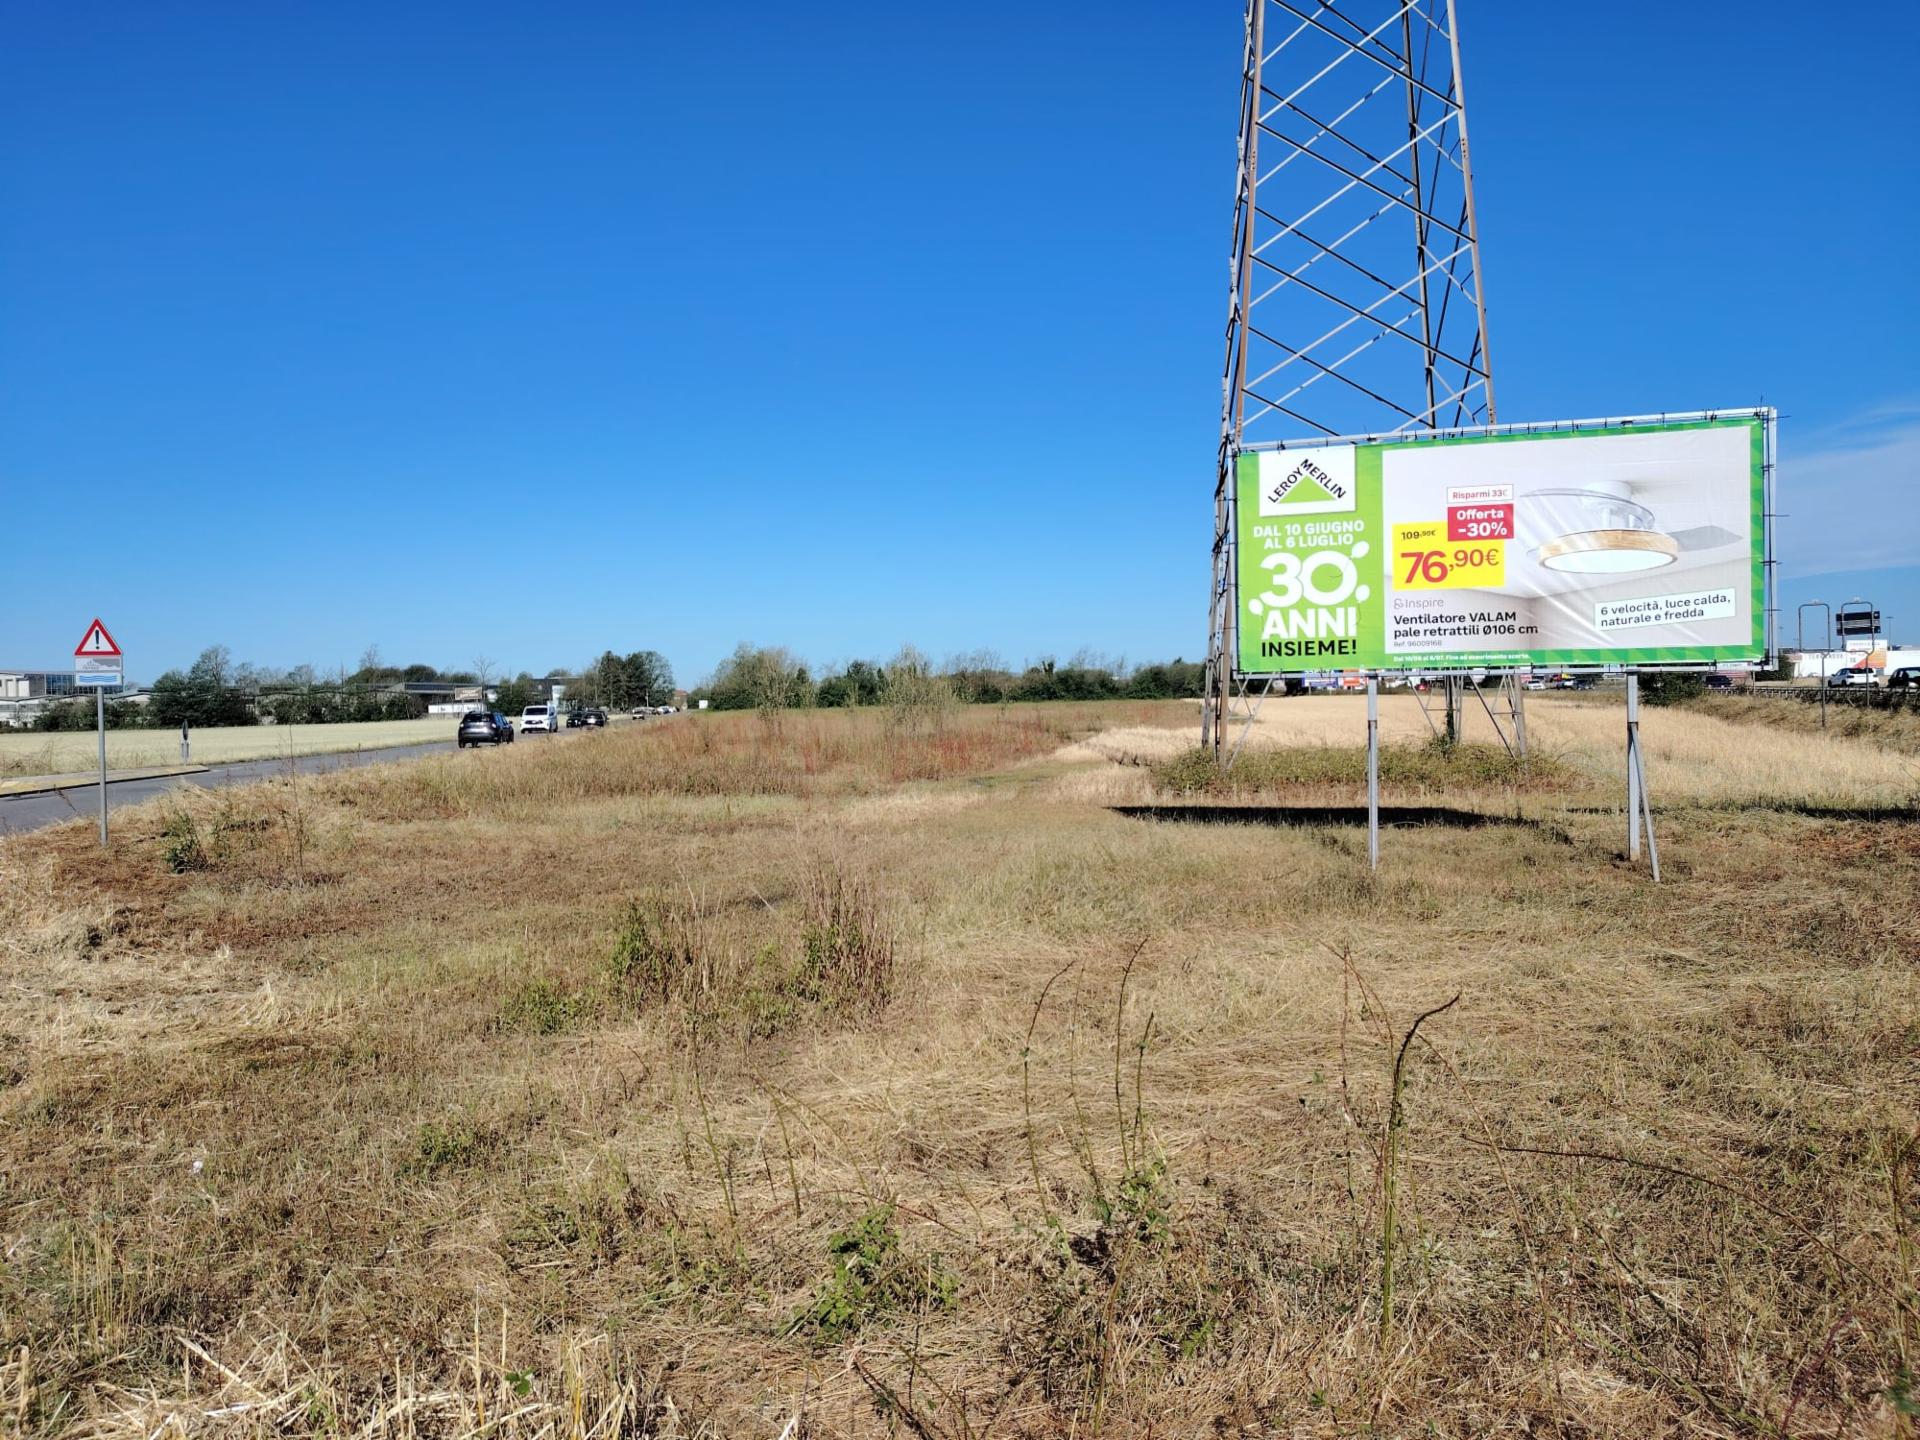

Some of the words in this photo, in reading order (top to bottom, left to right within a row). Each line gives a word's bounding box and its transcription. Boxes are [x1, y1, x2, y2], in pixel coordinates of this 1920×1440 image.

[1267, 466, 1303, 503] LEROY
[1300, 458, 1347, 499] MERLIN
[1452, 490, 1490, 500] Risparmi
[1456, 508, 1504, 520] Offerta
[1253, 526, 1281, 537] DAL
[1285, 524, 1301, 536] 10
[1304, 520, 1365, 534] GIUGNO
[1457, 521, 1508, 537] -30%
[1264, 538, 1282, 549] AL
[1286, 536, 1296, 548] 6
[1299, 533, 1353, 547] LUGLIO
[1400, 548, 1499, 584] 76,90€
[1259, 550, 1358, 608] 30
[1600, 606, 1608, 616] 6
[1611, 600, 1662, 614] velocità,
[1665, 599, 1691, 609] luce
[1693, 594, 1731, 606] calda,
[1261, 606, 1357, 640] ANNI
[1393, 613, 1466, 625] Ventilatore
[1469, 611, 1516, 622] VALAM
[1600, 613, 1651, 627] naturale
[1654, 613, 1661, 622] e
[1664, 608, 1704, 621] fredda
[1393, 627, 1420, 640] pale
[1423, 624, 1479, 637] retrattili
[1483, 624, 1516, 635] Ø106
[1518, 625, 1538, 634] cm
[1261, 639, 1357, 657] INSIEME!
